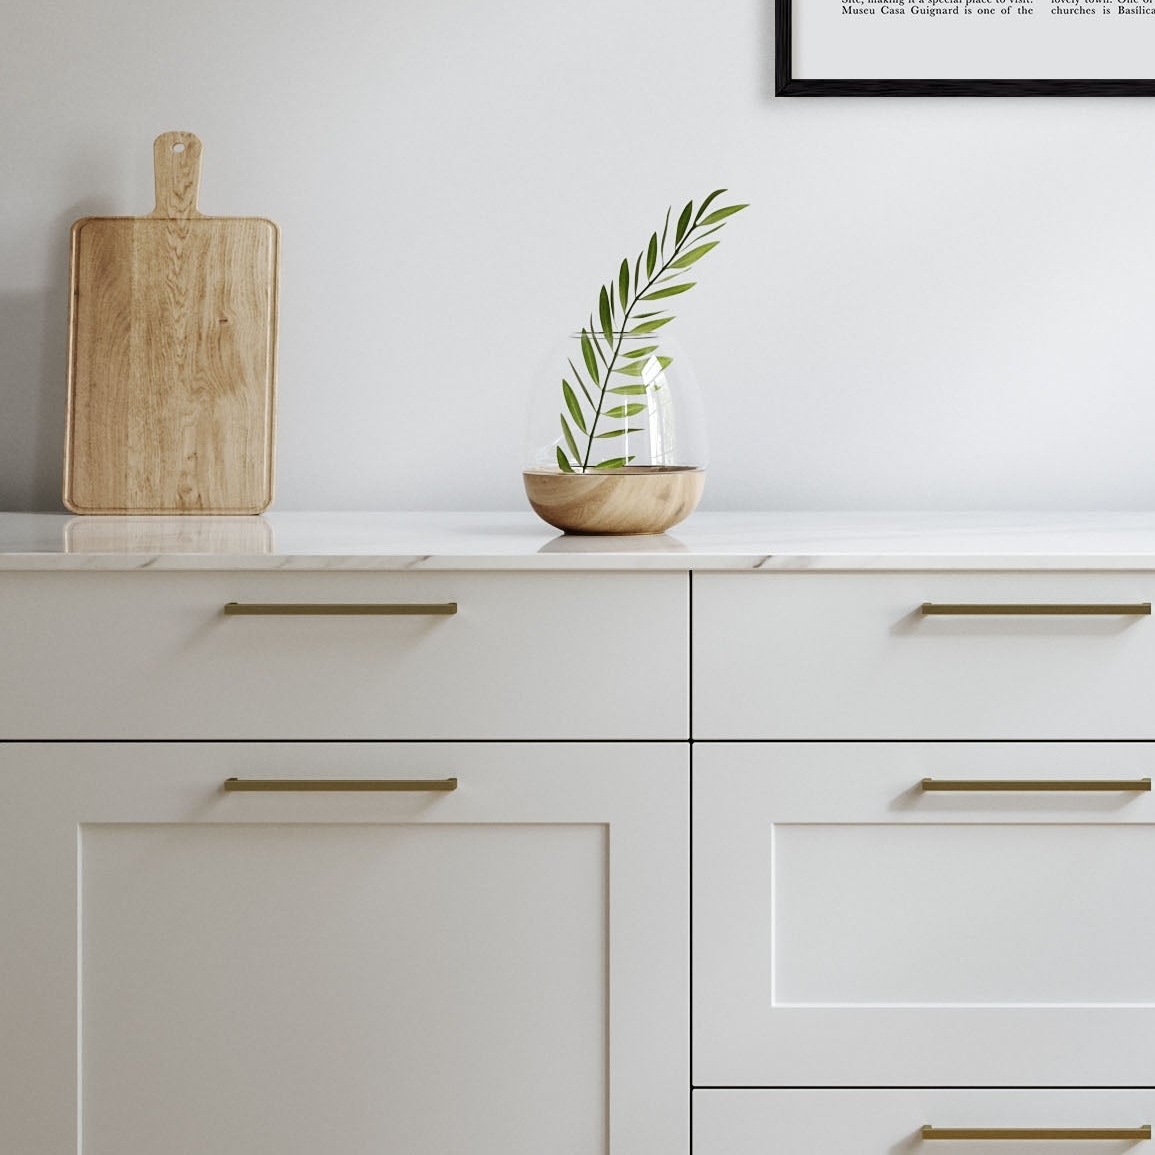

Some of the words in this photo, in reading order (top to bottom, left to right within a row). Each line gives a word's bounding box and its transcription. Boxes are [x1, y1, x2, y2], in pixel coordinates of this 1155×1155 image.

[842, 6, 875, 14] Museu
[880, 6, 905, 14] Casa
[910, 6, 959, 17] Guignard
[964, 6, 973, 14] is
[1000, 6, 1011, 14] of
[1017, 6, 1034, 14] the
[1051, 6, 1096, 14] churches
[1103, 6, 1111, 14] is
